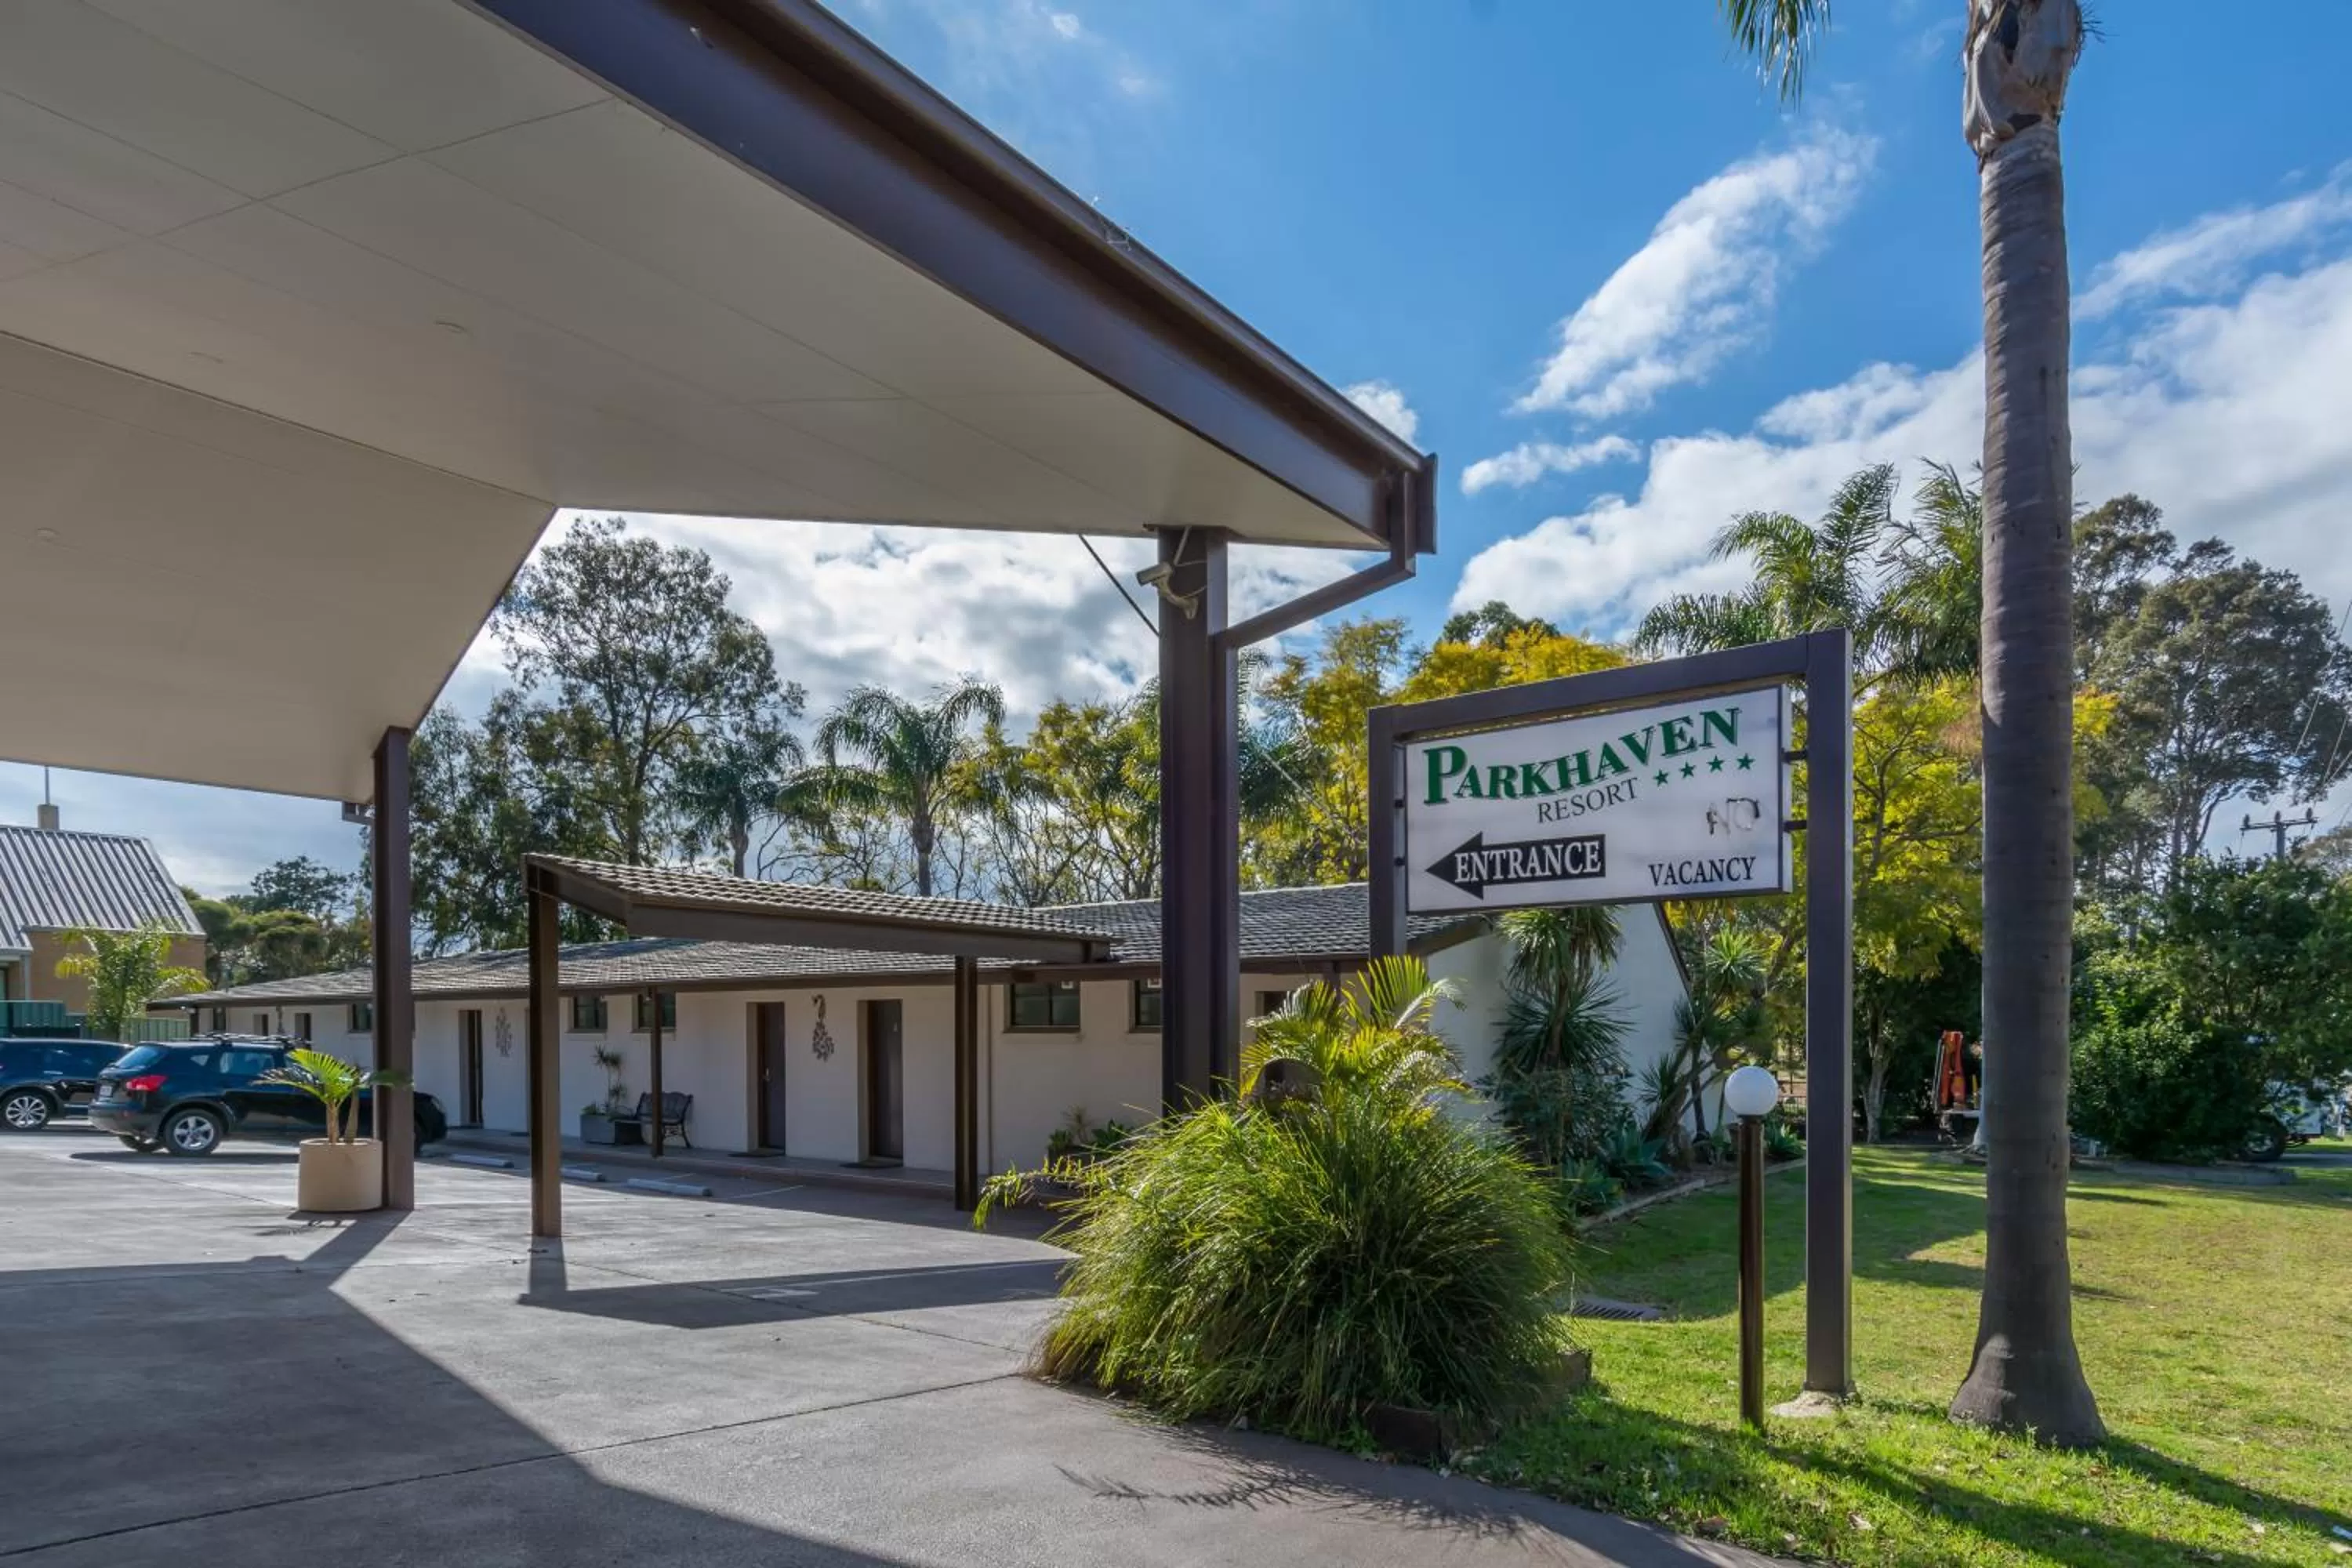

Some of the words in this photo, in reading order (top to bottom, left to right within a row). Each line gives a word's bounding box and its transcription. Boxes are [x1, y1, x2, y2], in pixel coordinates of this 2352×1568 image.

[1422, 708, 1742, 806] PARKHAVEN
[1537, 777, 1638, 823] RESORT
[1454, 840, 1602, 884] ENTRANCE
[1648, 856, 1756, 887] VACANCY
